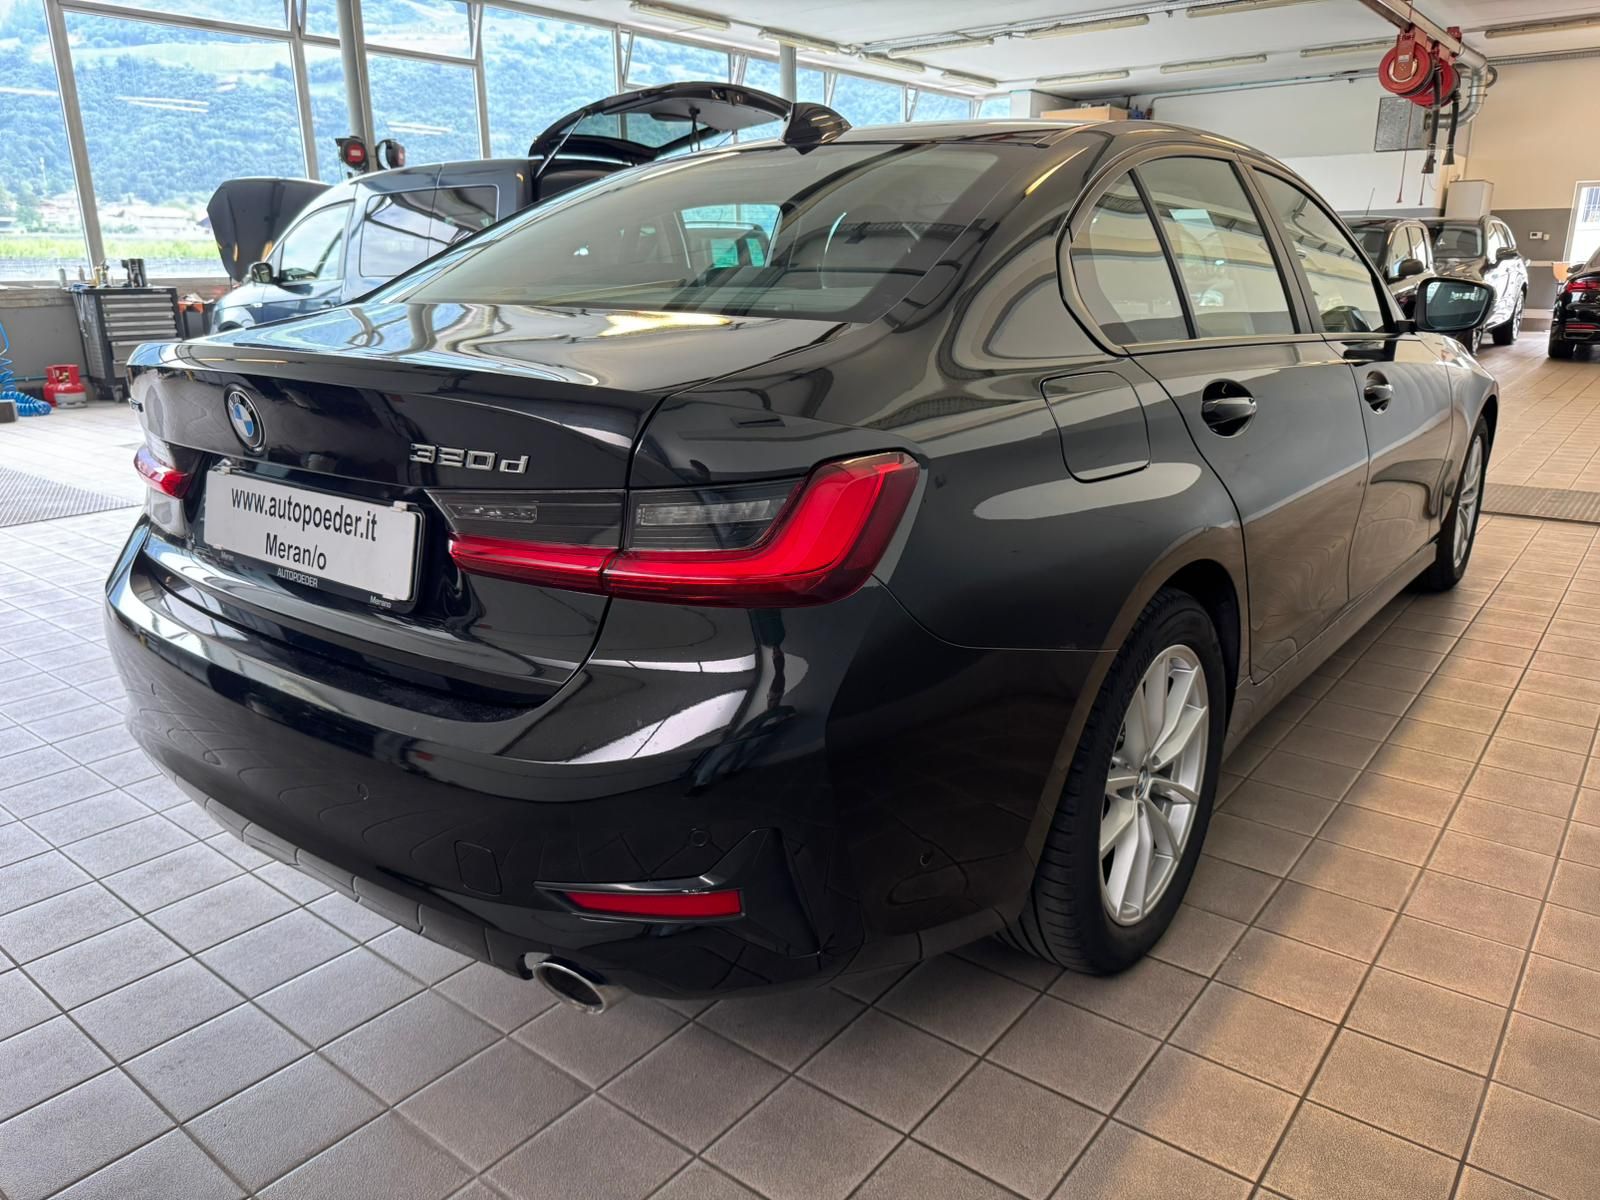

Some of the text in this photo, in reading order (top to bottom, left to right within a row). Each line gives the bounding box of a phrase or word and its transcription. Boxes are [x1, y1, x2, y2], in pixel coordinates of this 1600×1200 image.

[409, 442, 529, 474] 320d
[231, 487, 377, 542] www.autopoeder.it
[265, 532, 327, 570] Meran/o
[276, 568, 318, 588] AUTOPOEDER
